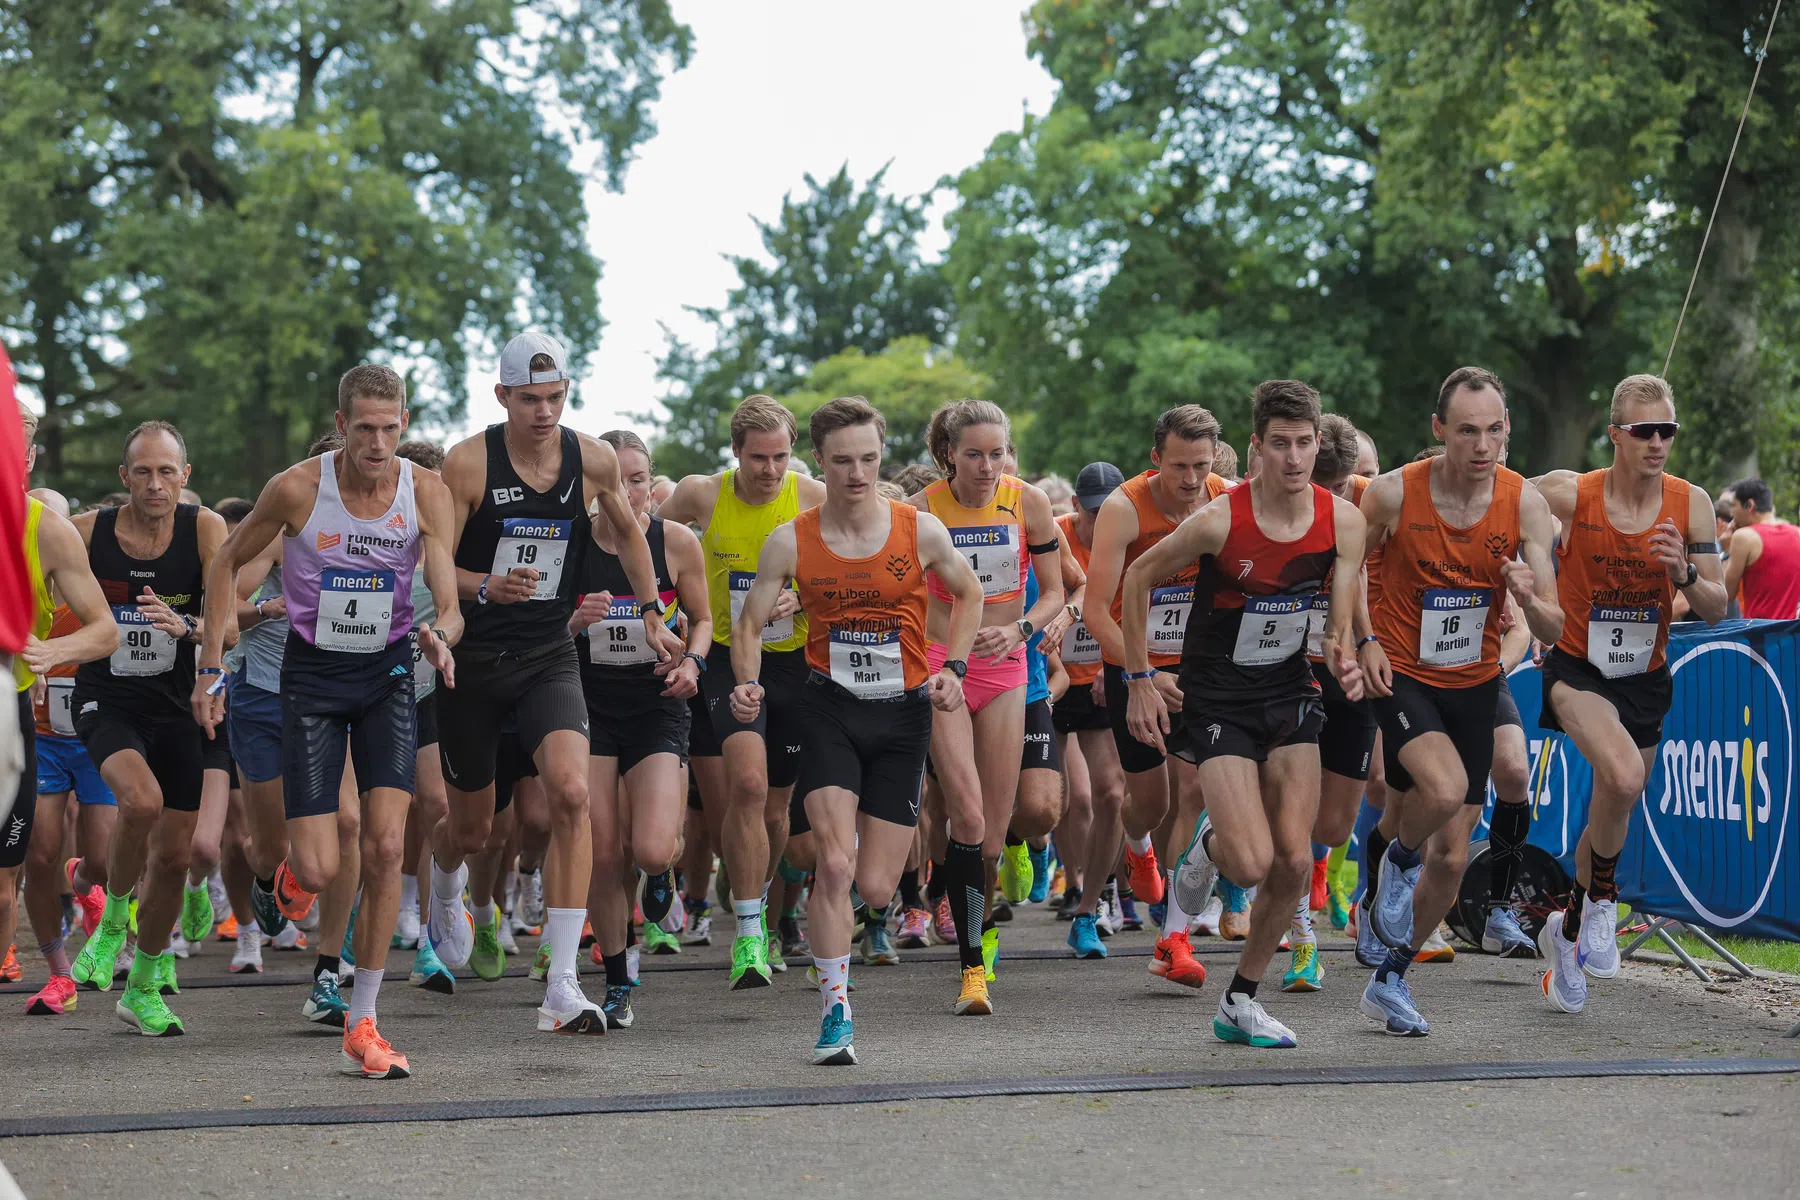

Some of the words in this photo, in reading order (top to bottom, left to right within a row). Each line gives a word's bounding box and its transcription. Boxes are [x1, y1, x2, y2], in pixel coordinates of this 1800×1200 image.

[492, 487, 524, 505] BC
[513, 524, 561, 538] menzis
[954, 529, 1000, 544] menzis
[346, 545, 369, 556] lab
[516, 544, 538, 564] 19
[970, 553, 978, 570] 1
[1432, 561, 1471, 573] Libero
[1607, 557, 1646, 569] Libero
[1605, 568, 1666, 579] Financieel
[332, 574, 384, 590] menzis
[839, 589, 880, 600] Libero
[1160, 588, 1196, 603] menzi
[1434, 593, 1482, 607] menzis
[344, 599, 358, 619] 4
[1255, 598, 1303, 612] menzis
[1163, 609, 1182, 626] 21
[1600, 608, 1650, 622] menzis
[331, 621, 377, 635] Yannick
[1263, 620, 1277, 636] 5
[1441, 615, 1461, 636] 16
[127, 631, 152, 648] 90
[606, 626, 628, 641] 18
[840, 630, 890, 644] menzis
[1154, 630, 1186, 641] Bastia
[1611, 628, 1624, 647] 3
[609, 644, 637, 653] Aline
[1073, 643, 1100, 653] Jeroen
[1259, 639, 1280, 649] Ties
[1435, 636, 1470, 653] Martijn
[130, 650, 157, 661] Mark
[849, 651, 873, 668] 91
[1608, 651, 1635, 664] Niels
[854, 671, 881, 683] Mart
[1398, 711, 1411, 730] FUSION
[1361, 752, 1369, 771] FUSION
[1660, 705, 1771, 841] menzis
[6, 813, 26, 847] RUNX
